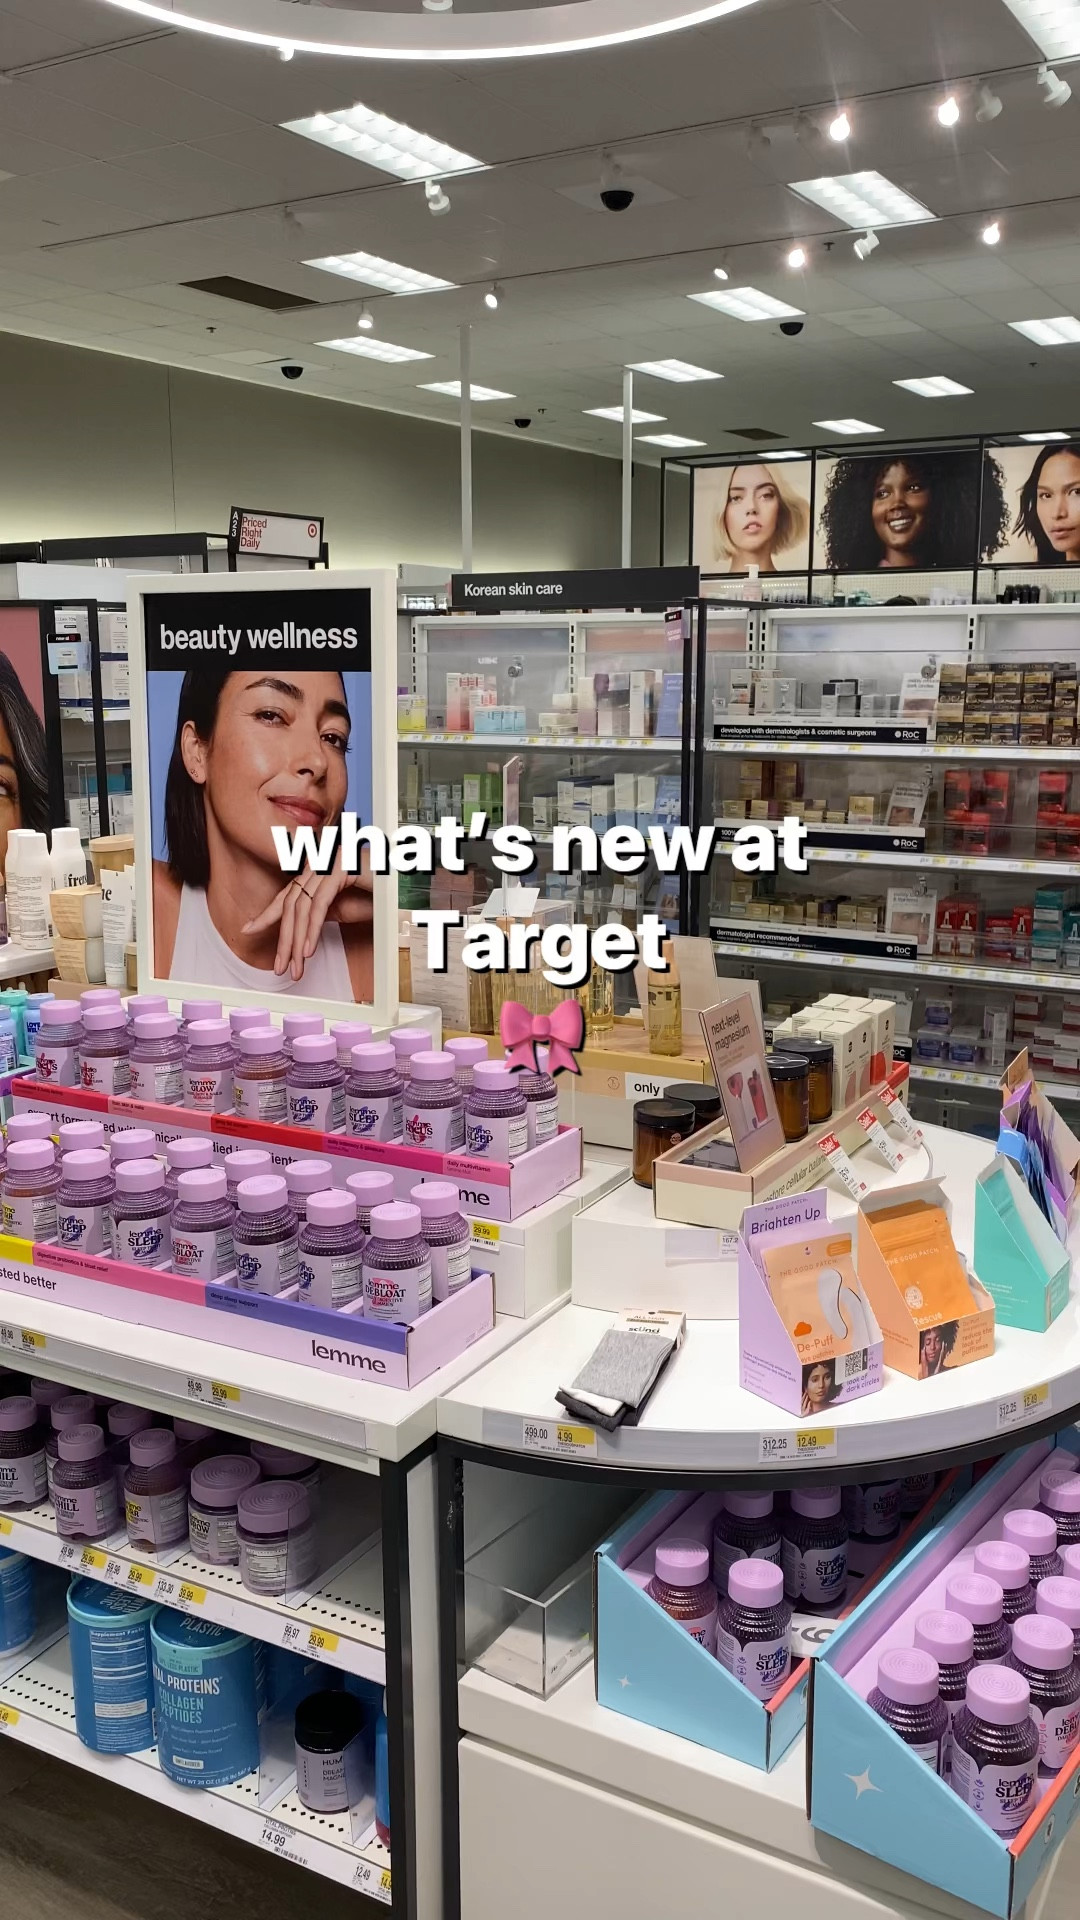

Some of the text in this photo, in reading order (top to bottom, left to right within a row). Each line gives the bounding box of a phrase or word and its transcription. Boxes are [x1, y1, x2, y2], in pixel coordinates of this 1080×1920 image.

[242, 517, 267, 528] Priced
[241, 527, 262, 539] Right
[240, 537, 260, 550] Daily
[464, 582, 563, 597] Korean skin care
[160, 622, 358, 655] beauty wellness
[765, 728, 810, 736] dermatologists
[902, 731, 920, 739] RoC
[901, 839, 918, 847] RoC
[717, 929, 756, 940] dermatologist
[756, 932, 799, 943] recommended
[894, 945, 910, 955] RoC
[711, 1011, 740, 1035] next-level
[715, 1024, 750, 1052] magnesium
[634, 1082, 660, 1096] only
[751, 1207, 821, 1235] Brighten Up
[128, 1233, 163, 1246] SLEEP
[129, 1228, 162, 1238] lemme
[23, 1271, 57, 1290] better
[367, 1278, 400, 1290] lemme
[365, 1287, 406, 1299] DEBLOAT
[912, 1312, 942, 1326] Rescue
[797, 1335, 834, 1353] De-Puff
[311, 1339, 386, 1373] lemme
[869, 1363, 879, 1371] the
[846, 1377, 880, 1393] dark circles
[211, 1386, 228, 1399] 29.99
[525, 1427, 573, 1442] 499.00 4.99
[762, 1436, 817, 1450] 312.25 12.49
[106, 1562, 121, 1575] 59.98
[128, 1570, 143, 1583] 29.99
[178, 1587, 194, 1600] 39.99
[127, 1627, 145, 1635] Facts
[180, 1618, 225, 1637] PLASTIC
[284, 1626, 324, 1648] 99.97 29.99
[168, 1675, 220, 1695] PROTEINS
[159, 1686, 204, 1711] COLLAGEN
[160, 1704, 203, 1724] PEPTIDES
[261, 1828, 286, 1846] 14.99
[355, 1865, 392, 1890] 12.49 14.9
